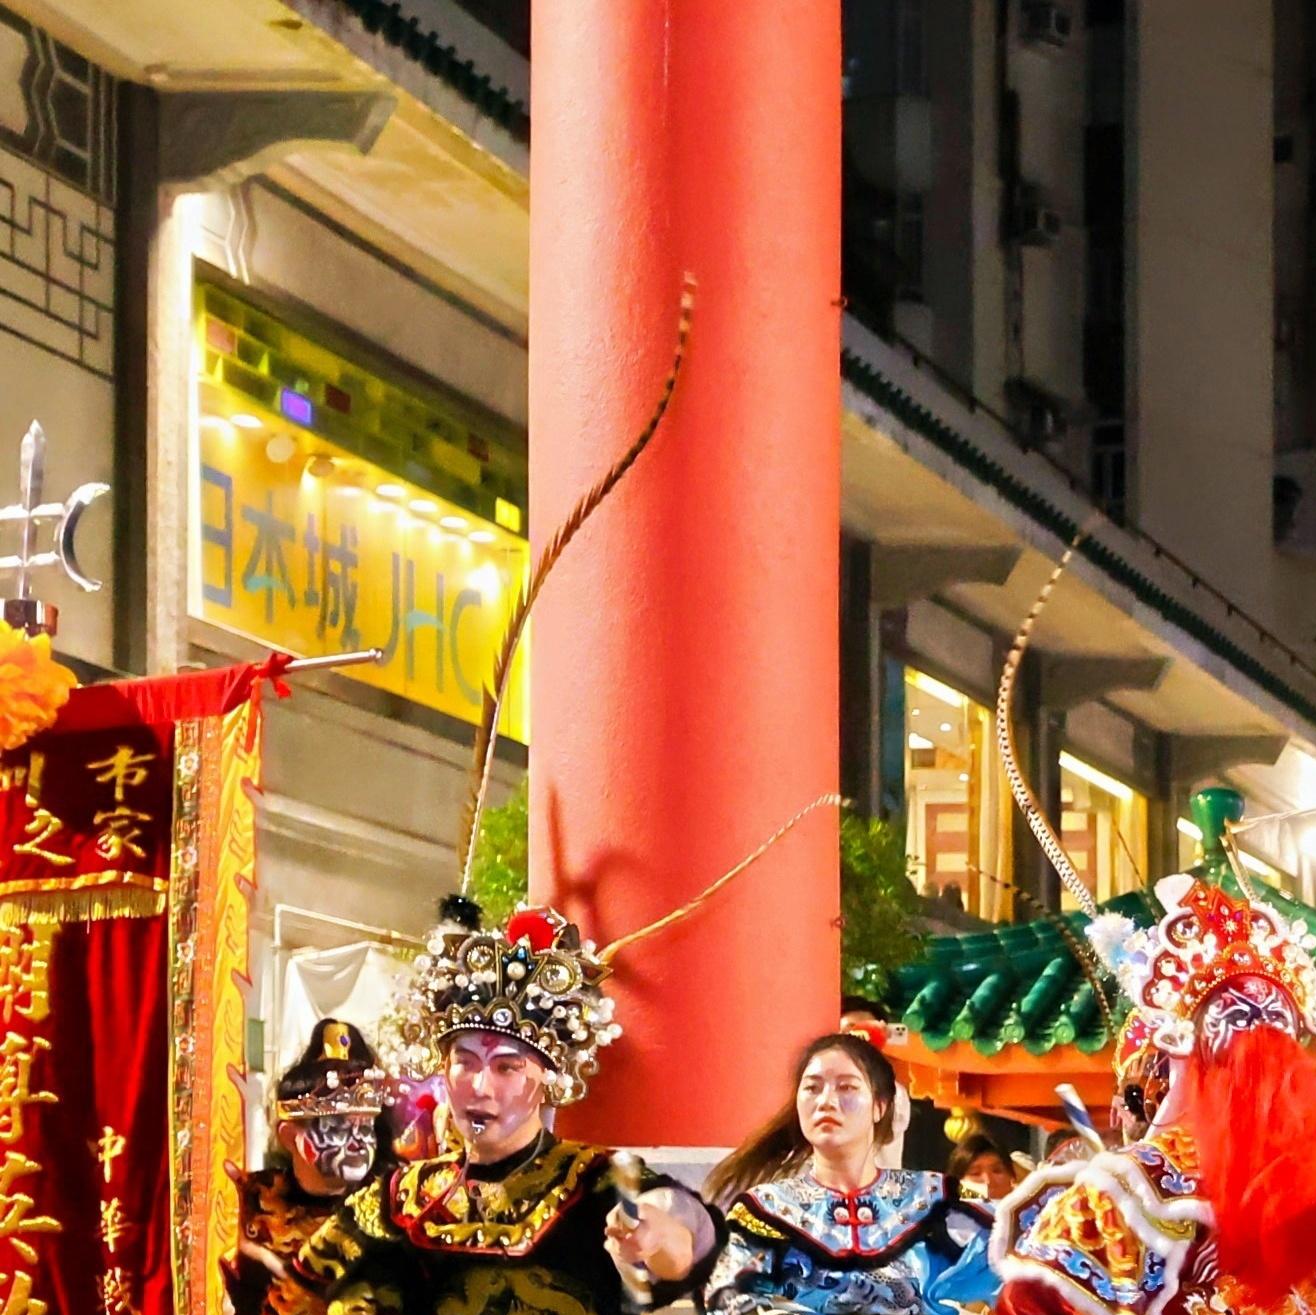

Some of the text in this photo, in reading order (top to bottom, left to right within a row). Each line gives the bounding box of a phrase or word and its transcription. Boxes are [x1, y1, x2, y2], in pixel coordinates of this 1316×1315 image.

[203, 463, 484, 707] 日本城 JHC
